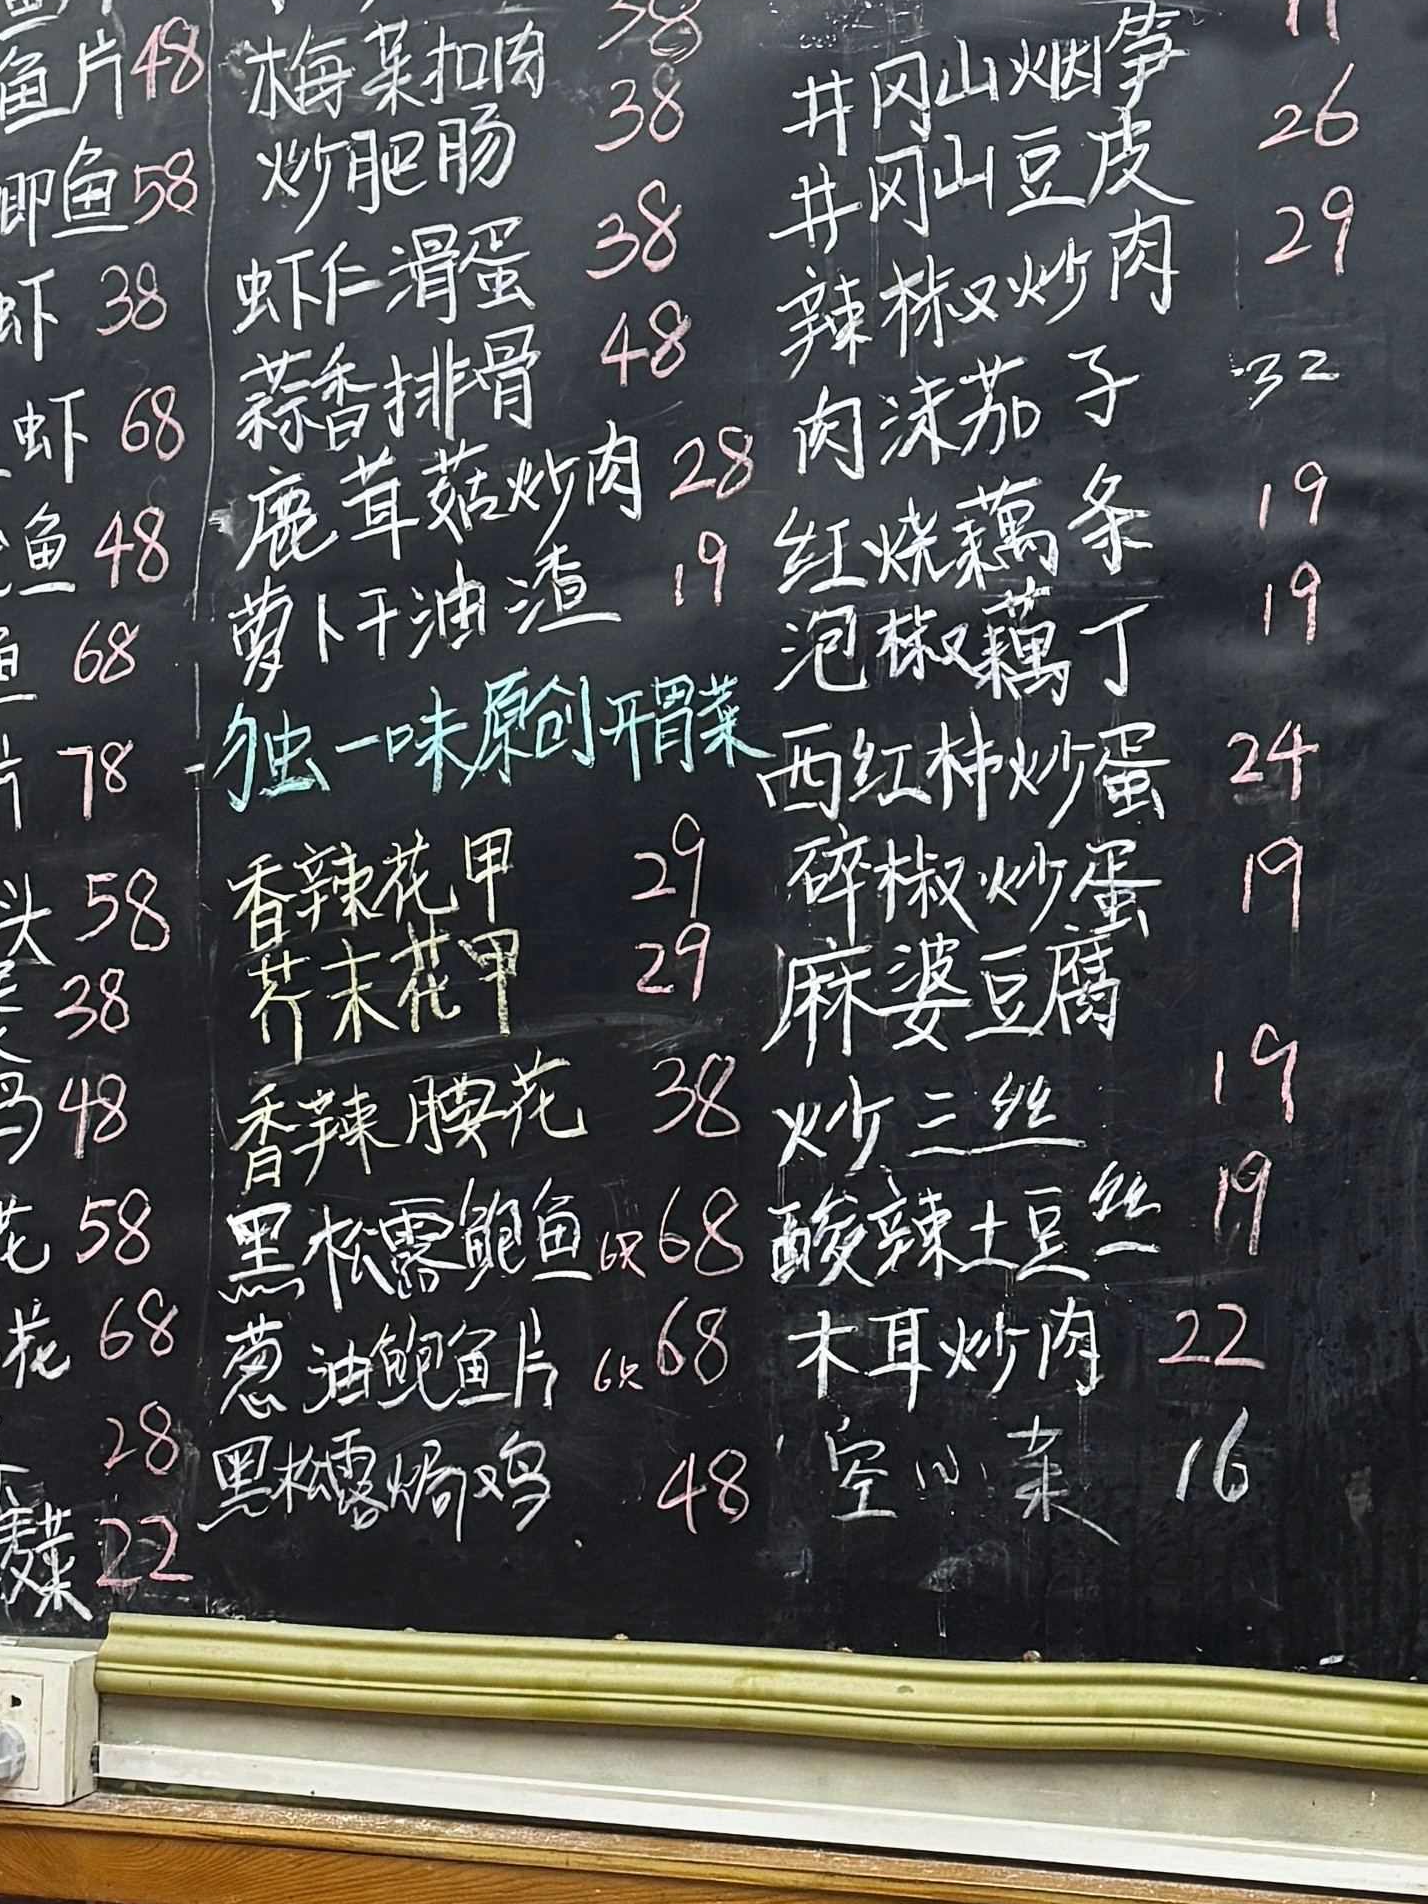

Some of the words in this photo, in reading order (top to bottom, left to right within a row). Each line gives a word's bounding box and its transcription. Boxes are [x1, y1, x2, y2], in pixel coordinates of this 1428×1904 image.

[130, 16, 203, 100] 48
[245, 20, 546, 120] 梅菜扣肉
[1258, 63, 1359, 150] 26
[133, 148, 199, 224] 58
[256, 104, 517, 233] 炒肥肠
[596, 78, 684, 152] 38
[97, 262, 167, 337] 38
[232, 217, 536, 336] 虾仁滑蛋
[586, 179, 682, 280] 38
[777, 208, 1179, 381] 辣椒炒肉
[1265, 185, 1354, 276] 29
[237, 324, 541, 452] 蒜香排骨
[600, 298, 691, 387] 48
[120, 385, 184, 462] 68
[237, 419, 643, 572] 鹿茸菇炒肉
[670, 426, 755, 499] 28
[1258, 462, 1328, 530] 19
[94, 506, 169, 588] 48
[228, 542, 622, 693] 萝卜干油渣
[674, 530, 728, 607] 19
[1262, 561, 1322, 644] 19
[73, 622, 139, 685] 68
[57, 741, 132, 821] 78
[212, 667, 775, 813] 独一味原创开胃菜
[758, 706, 1172, 829] 西红柿炒蛋
[1228, 720, 1319, 800] 24
[76, 868, 171, 951] 58
[228, 827, 514, 951] 香辣花甲
[632, 812, 705, 919] 29
[1242, 836, 1303, 933] 19
[54, 968, 129, 1040] 38
[247, 915, 519, 1064] 芥末花甲
[636, 923, 711, 1000] 29
[763, 932, 1120, 1067] 麻婆豆腐
[58, 1074, 128, 1158] 48
[653, 1053, 741, 1138] 38
[776, 1072, 1087, 1176] 炒三丝
[1214, 1025, 1298, 1122] 19
[76, 1188, 152, 1265] 58
[218, 1178, 592, 1313] 黑松露鲍鱼
[768, 1160, 1161, 1287] 酸辣土豆丝
[100, 1289, 177, 1361] 68
[219, 1307, 559, 1419] 葱油鲍鱼片
[787, 1297, 1101, 1412] 木耳炒肉
[104, 1401, 180, 1476] 28
[657, 1448, 751, 1535] 48
[97, 1515, 193, 1587] 22
